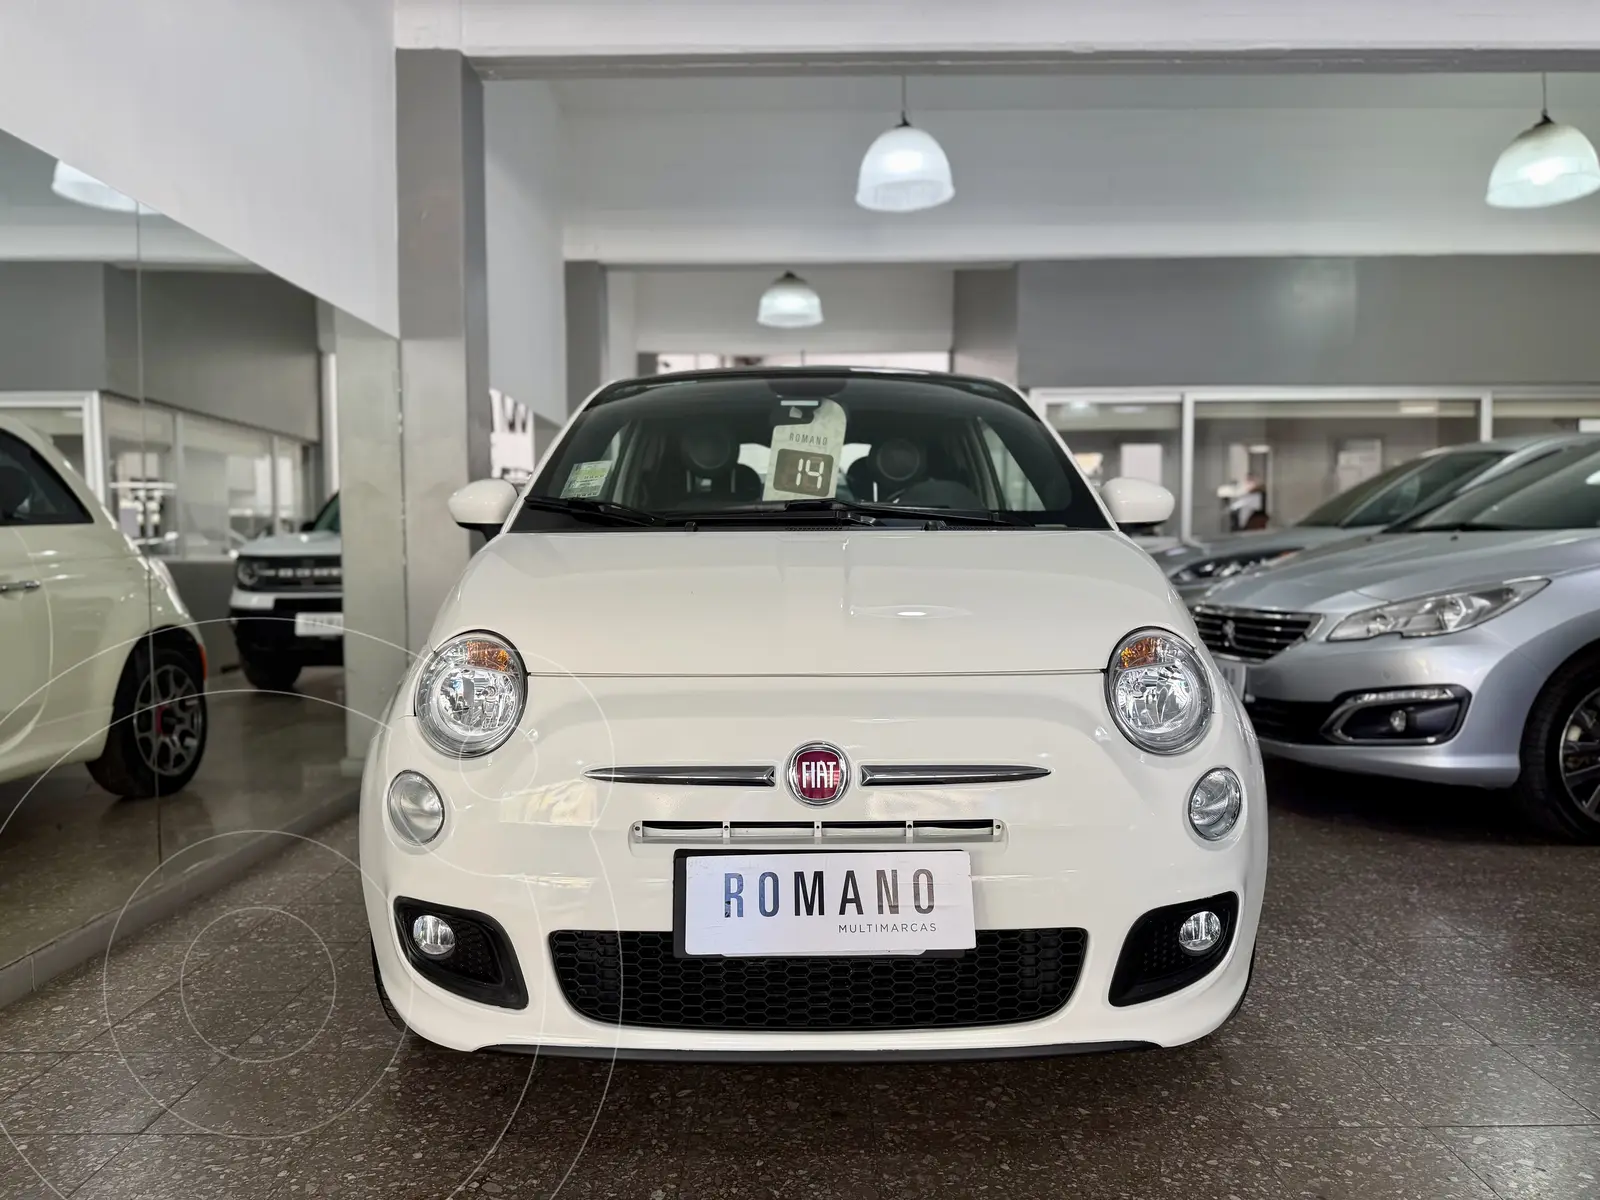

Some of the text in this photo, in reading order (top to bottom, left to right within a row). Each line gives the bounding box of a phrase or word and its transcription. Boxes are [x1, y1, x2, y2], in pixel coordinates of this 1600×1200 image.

[789, 432, 828, 446] ROMANO
[796, 458, 825, 490] 14
[802, 760, 836, 789] FIAT
[724, 868, 935, 918] ROMANO
[838, 922, 937, 934] MULTIMARCAS
